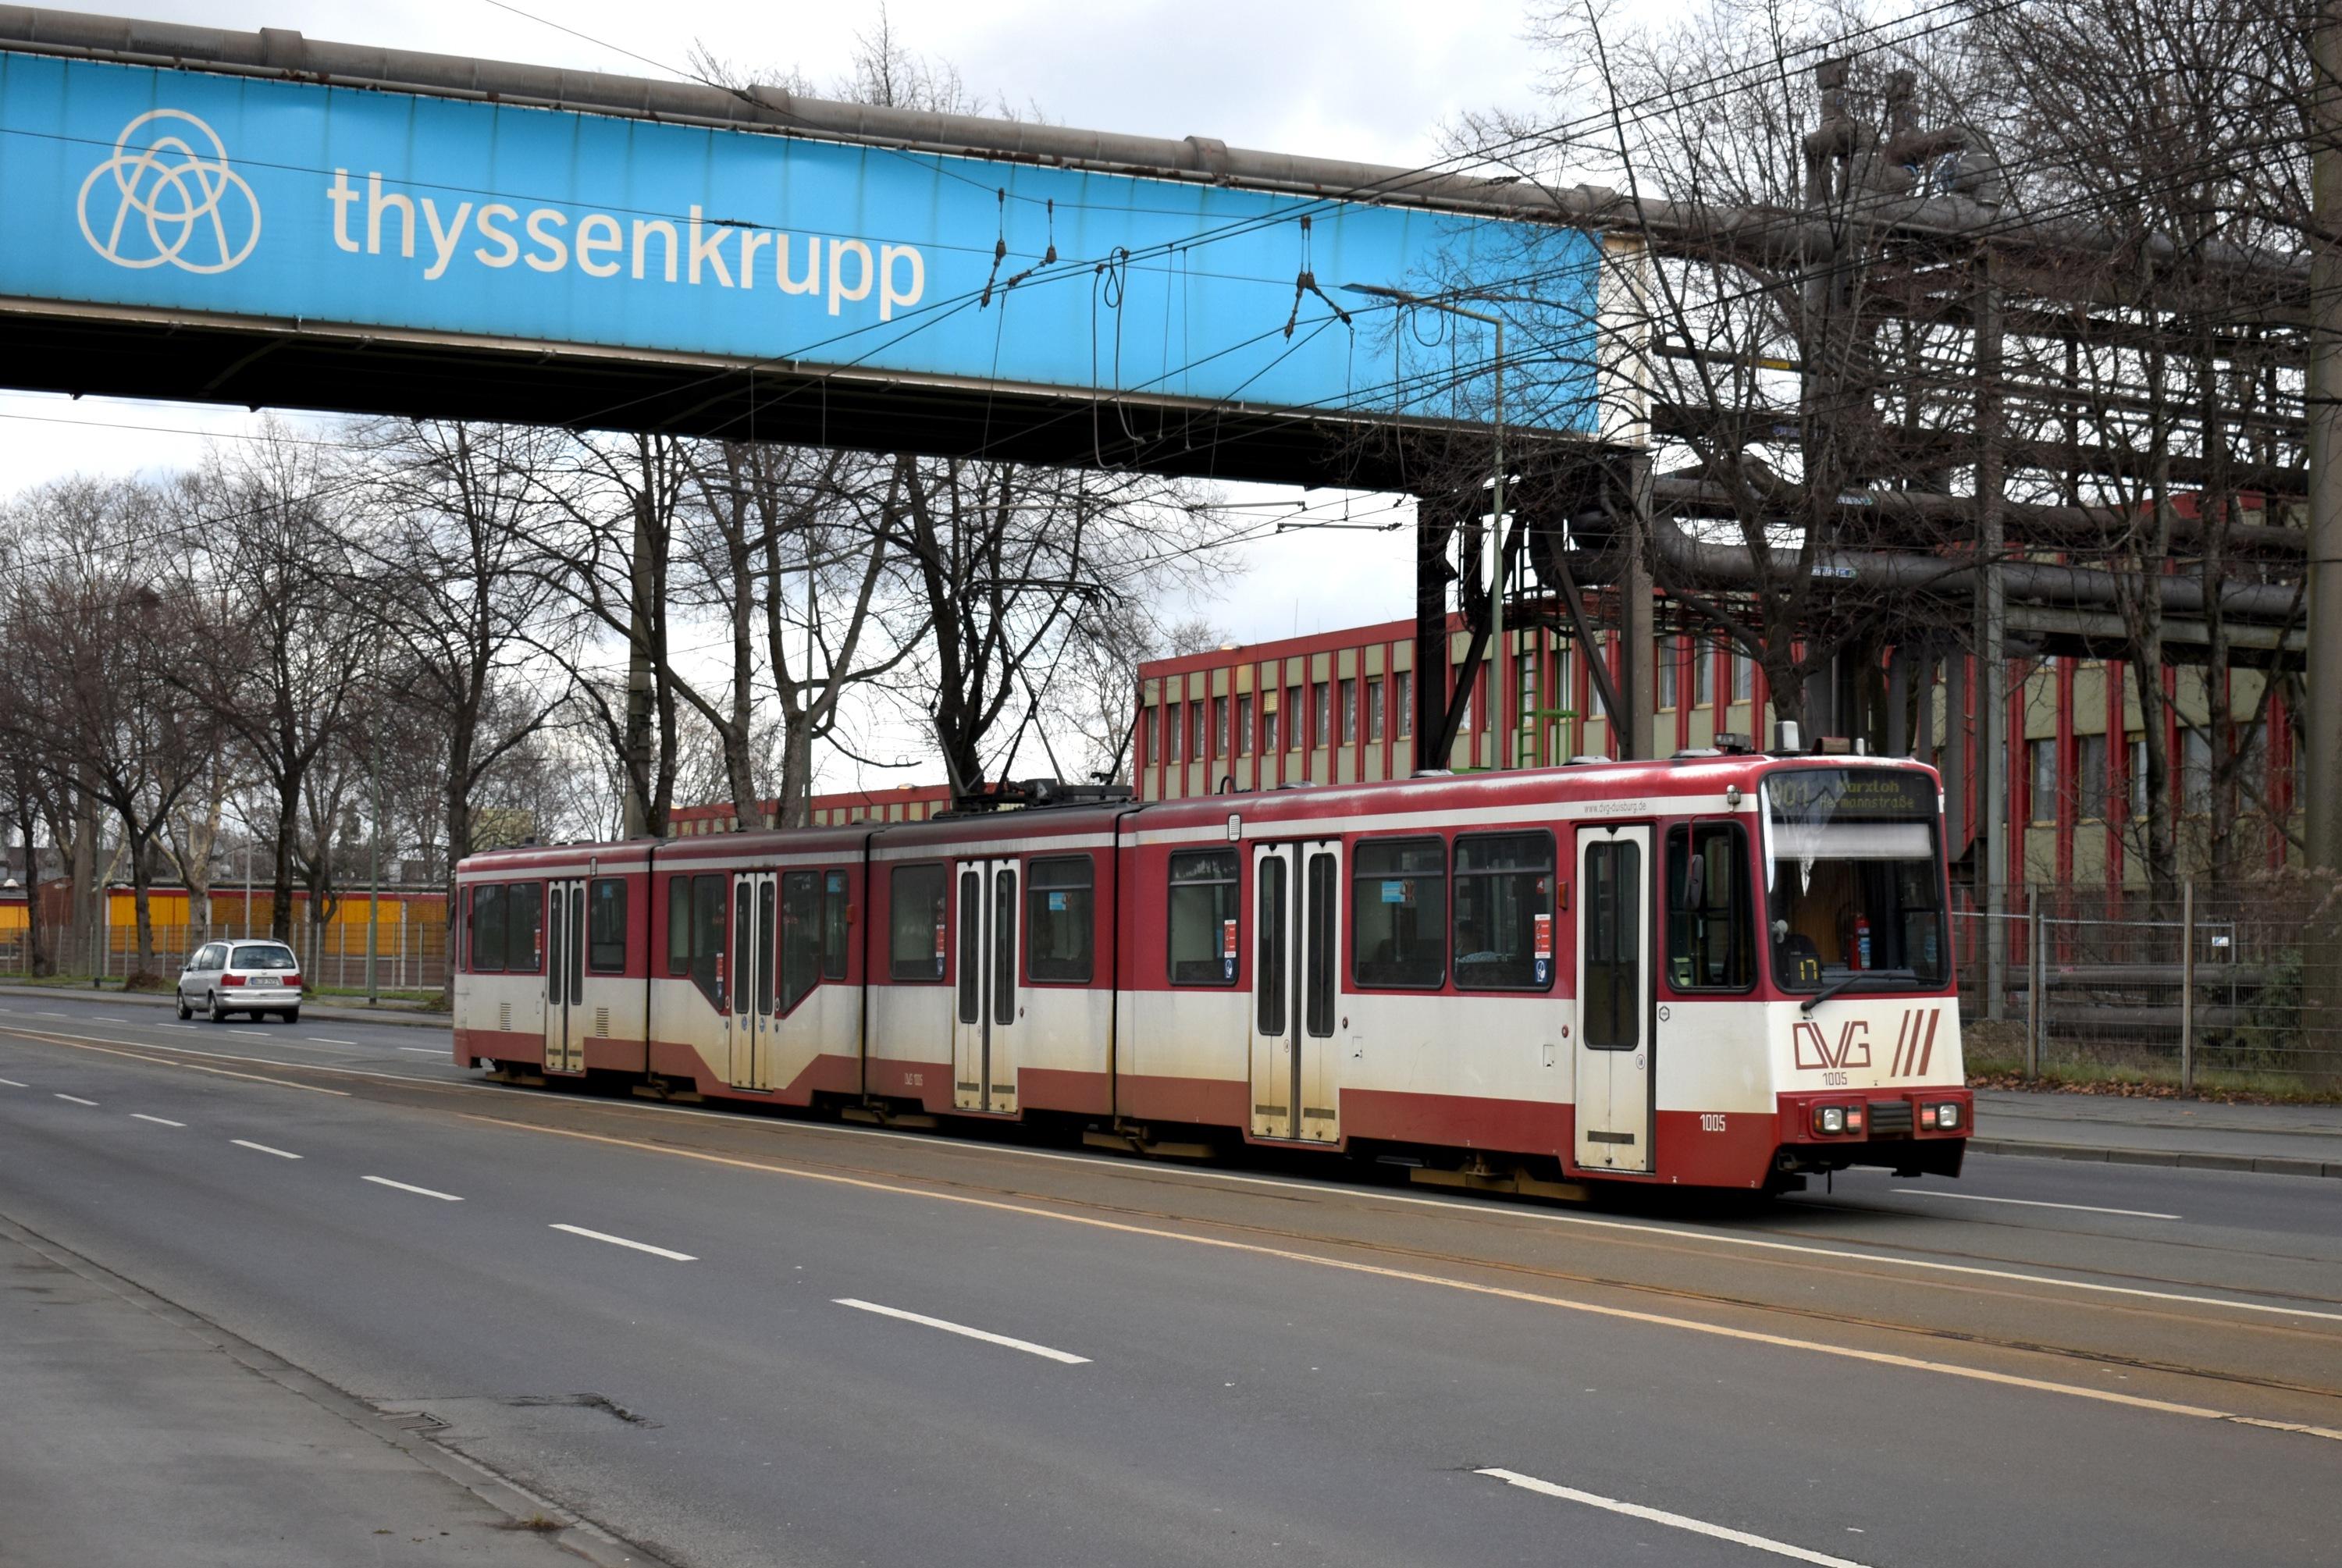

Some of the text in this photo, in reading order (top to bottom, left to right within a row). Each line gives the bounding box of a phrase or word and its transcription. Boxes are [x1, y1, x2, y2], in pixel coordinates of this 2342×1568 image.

[327, 168, 925, 321] thyssenkrupp
[1836, 780, 1899, 793] Marxloh
[1584, 802, 1646, 814] www.dvg-duisburg.de
[1820, 795, 1915, 809] Hermannstraße
[1799, 958, 1817, 980] 17
[1792, 1021, 1871, 1070] DVG
[1823, 1072, 1848, 1086] 1005
[1700, 1114, 1726, 1132] 1005
